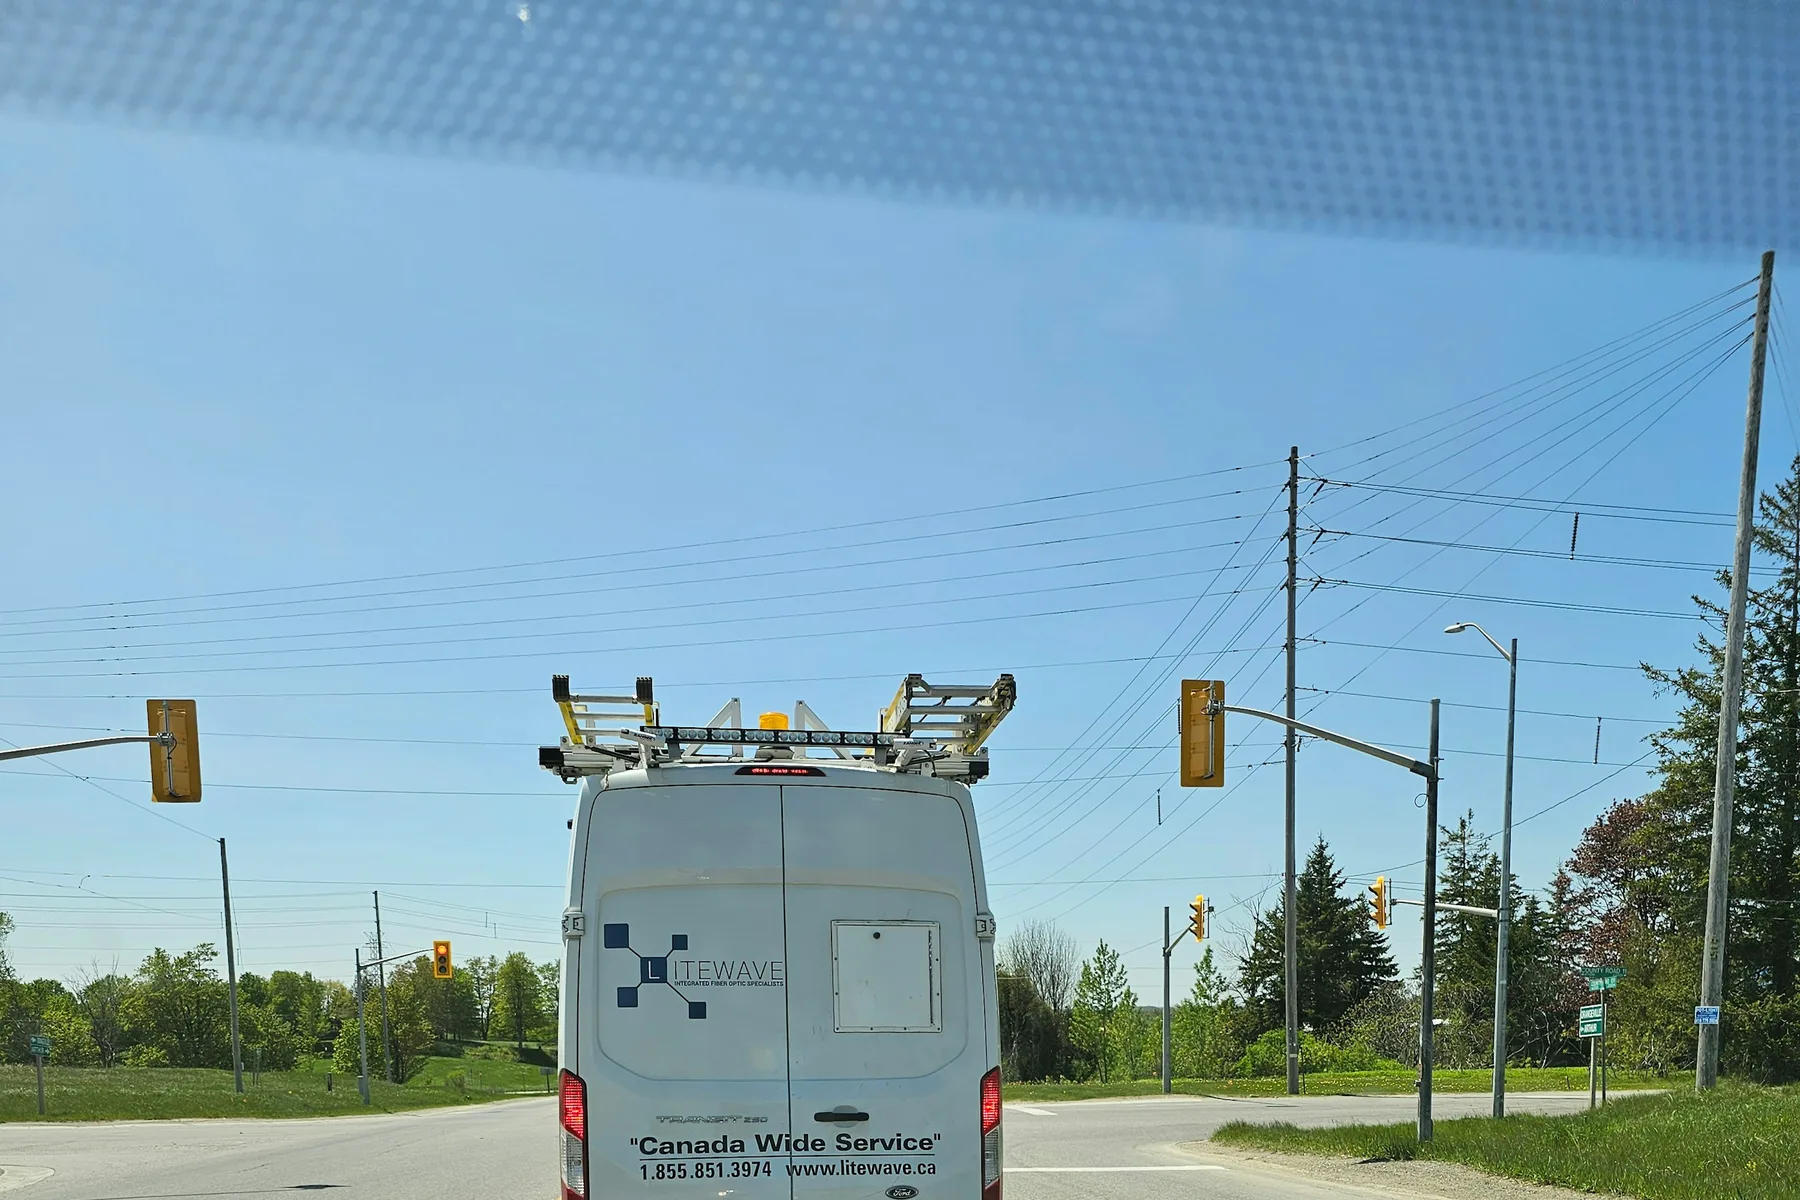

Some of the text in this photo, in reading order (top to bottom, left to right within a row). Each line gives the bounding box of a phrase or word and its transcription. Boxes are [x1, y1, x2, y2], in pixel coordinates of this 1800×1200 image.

[1581, 967, 1603, 975] COUNTY
[1605, 967, 1621, 975] ROAD
[656, 1115, 743, 1124] TRANSIT
[630, 1133, 941, 1155] "Canada Wide Service"
[640, 1160, 936, 1180] 1.855.851.3974 www.litewave.ca
